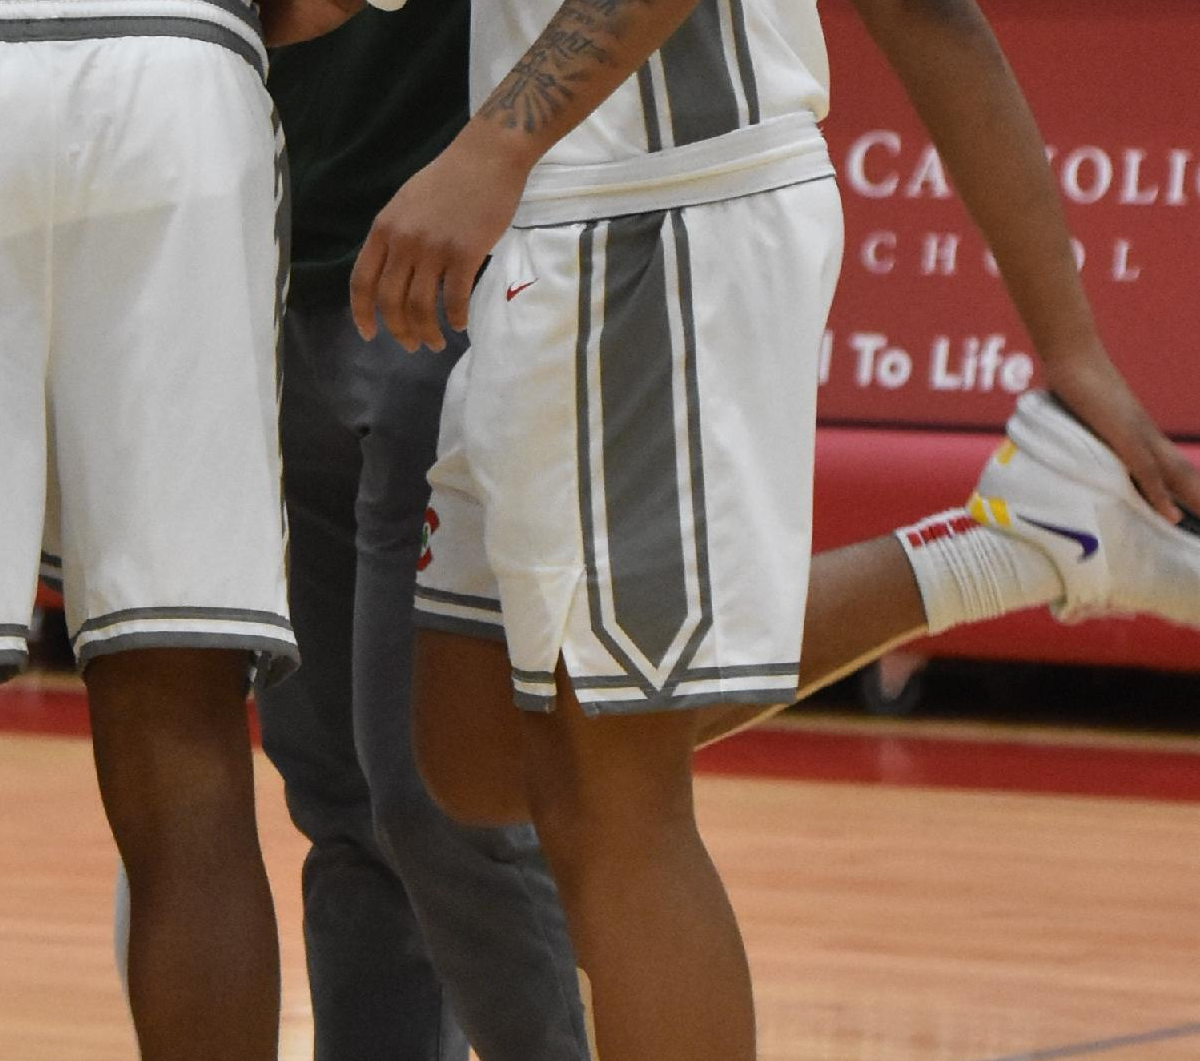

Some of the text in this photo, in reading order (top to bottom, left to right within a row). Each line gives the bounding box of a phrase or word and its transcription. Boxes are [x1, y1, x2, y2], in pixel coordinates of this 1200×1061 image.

[845, 129, 1200, 206] CAOLI
[850, 333, 913, 389] To
[928, 335, 1034, 393] Life
